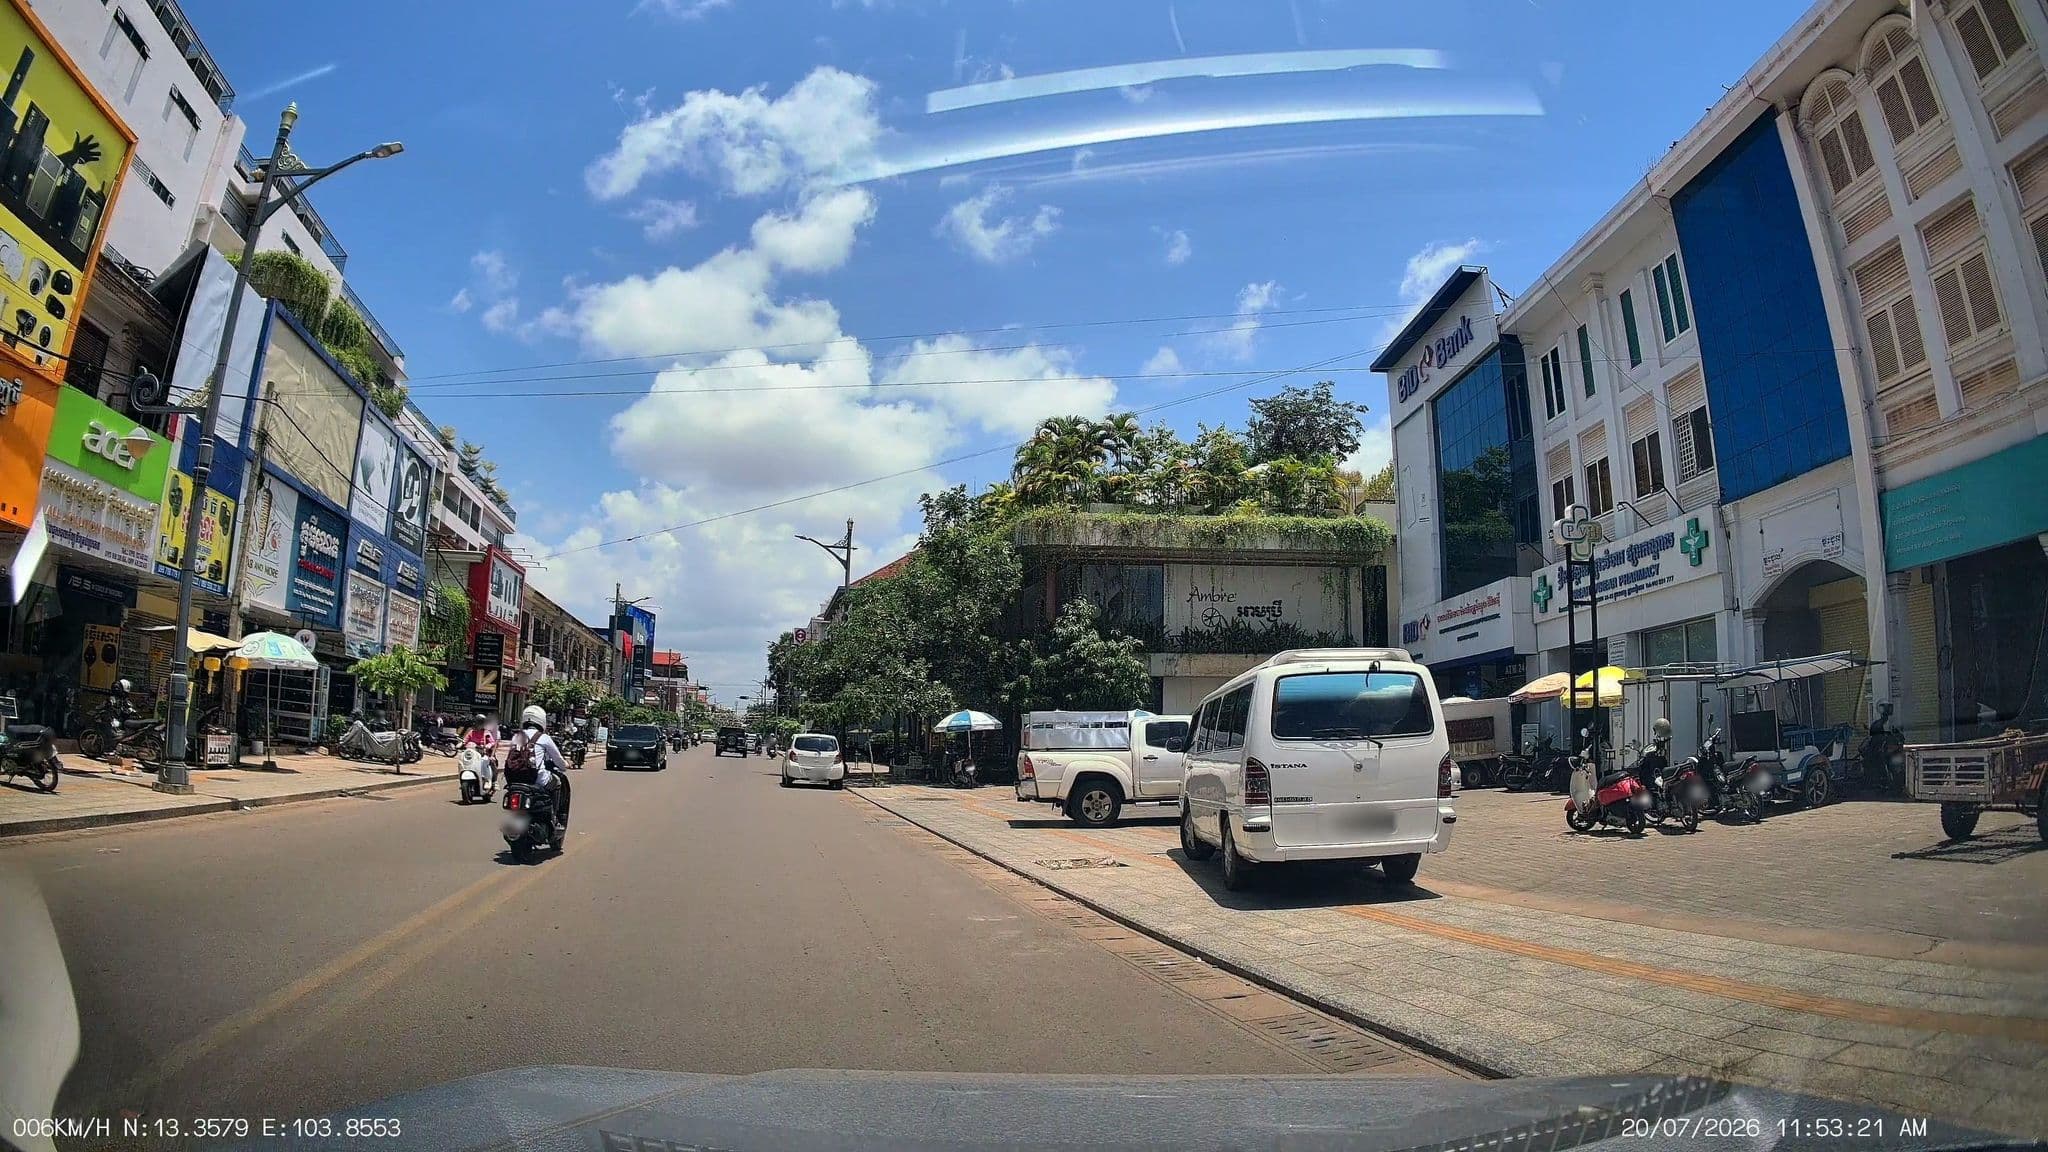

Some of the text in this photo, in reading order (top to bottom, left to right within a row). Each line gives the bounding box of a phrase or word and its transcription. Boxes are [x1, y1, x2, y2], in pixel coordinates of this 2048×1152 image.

[1435, 315, 1474, 369] Bank
[1619, 563, 1660, 588] PHARMACY
[1186, 585, 1237, 603] Ambre
